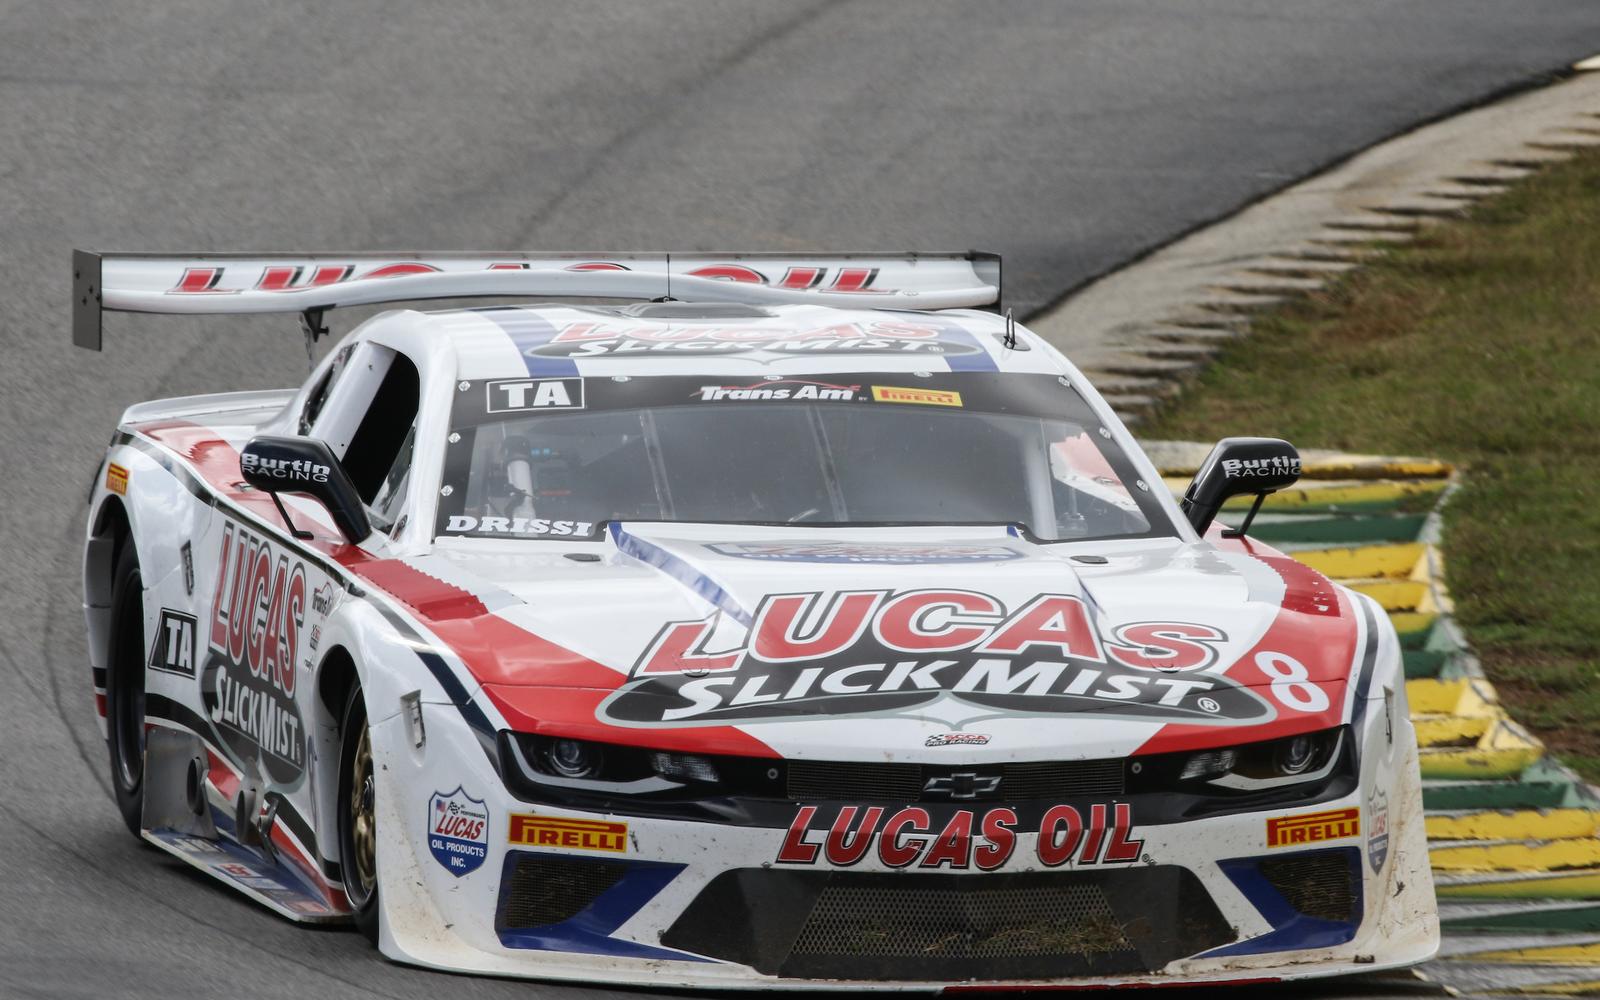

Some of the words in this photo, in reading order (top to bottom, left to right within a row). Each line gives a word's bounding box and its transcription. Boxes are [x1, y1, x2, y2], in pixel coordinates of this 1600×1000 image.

[550, 321, 943, 343] LUCAS
[568, 339, 938, 357] SLICKMIST
[499, 382, 571, 408] TA
[700, 386, 784, 400] Trans
[791, 385, 854, 400] Am
[241, 453, 330, 475] Burtin
[242, 465, 328, 483] RACING
[1221, 456, 1301, 471] Burtin
[1225, 467, 1300, 479] RACING
[446, 515, 593, 537] DRISSI
[208, 520, 306, 699] LUCAS
[166, 617, 192, 670] TA
[627, 588, 1228, 678] LUCAS
[661, 659, 1214, 721] SLICKMIST
[1254, 651, 1330, 712] 8
[211, 665, 299, 760] SLICKMIST
[435, 814, 485, 840] LUCAS
[510, 813, 627, 851] PIRELLI
[775, 805, 1018, 871] LUCAS
[1036, 803, 1146, 867] OIL
[1267, 808, 1360, 847] PIRELLI
[431, 840, 445, 850] OIL
[446, 842, 485, 858] PRODUCTS
[451, 856, 466, 868] INC.
